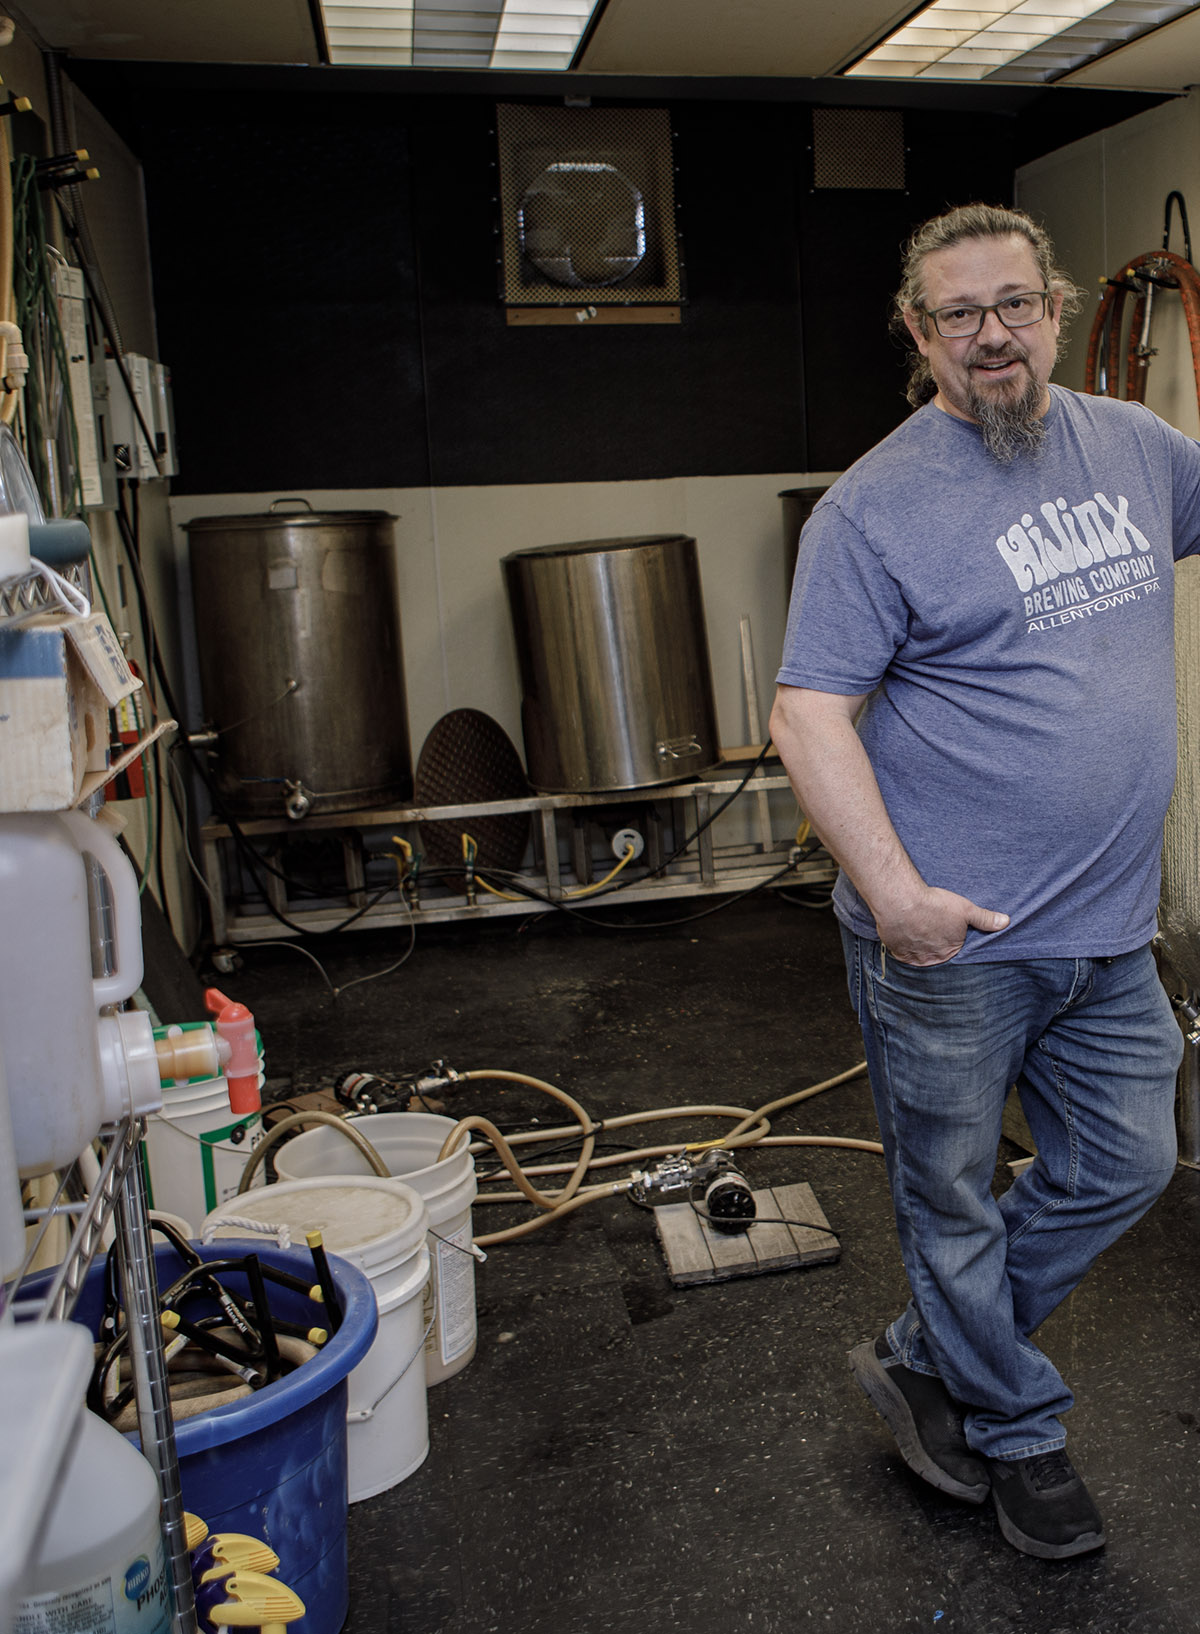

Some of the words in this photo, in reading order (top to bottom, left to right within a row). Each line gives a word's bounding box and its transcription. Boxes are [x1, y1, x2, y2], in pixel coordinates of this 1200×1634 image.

[1024, 575, 1090, 617] BREWING
[1089, 554, 1156, 593] COMPANY
[1027, 589, 1141, 634] ALLENTOWN,
[1144, 581, 1161, 594] PA
